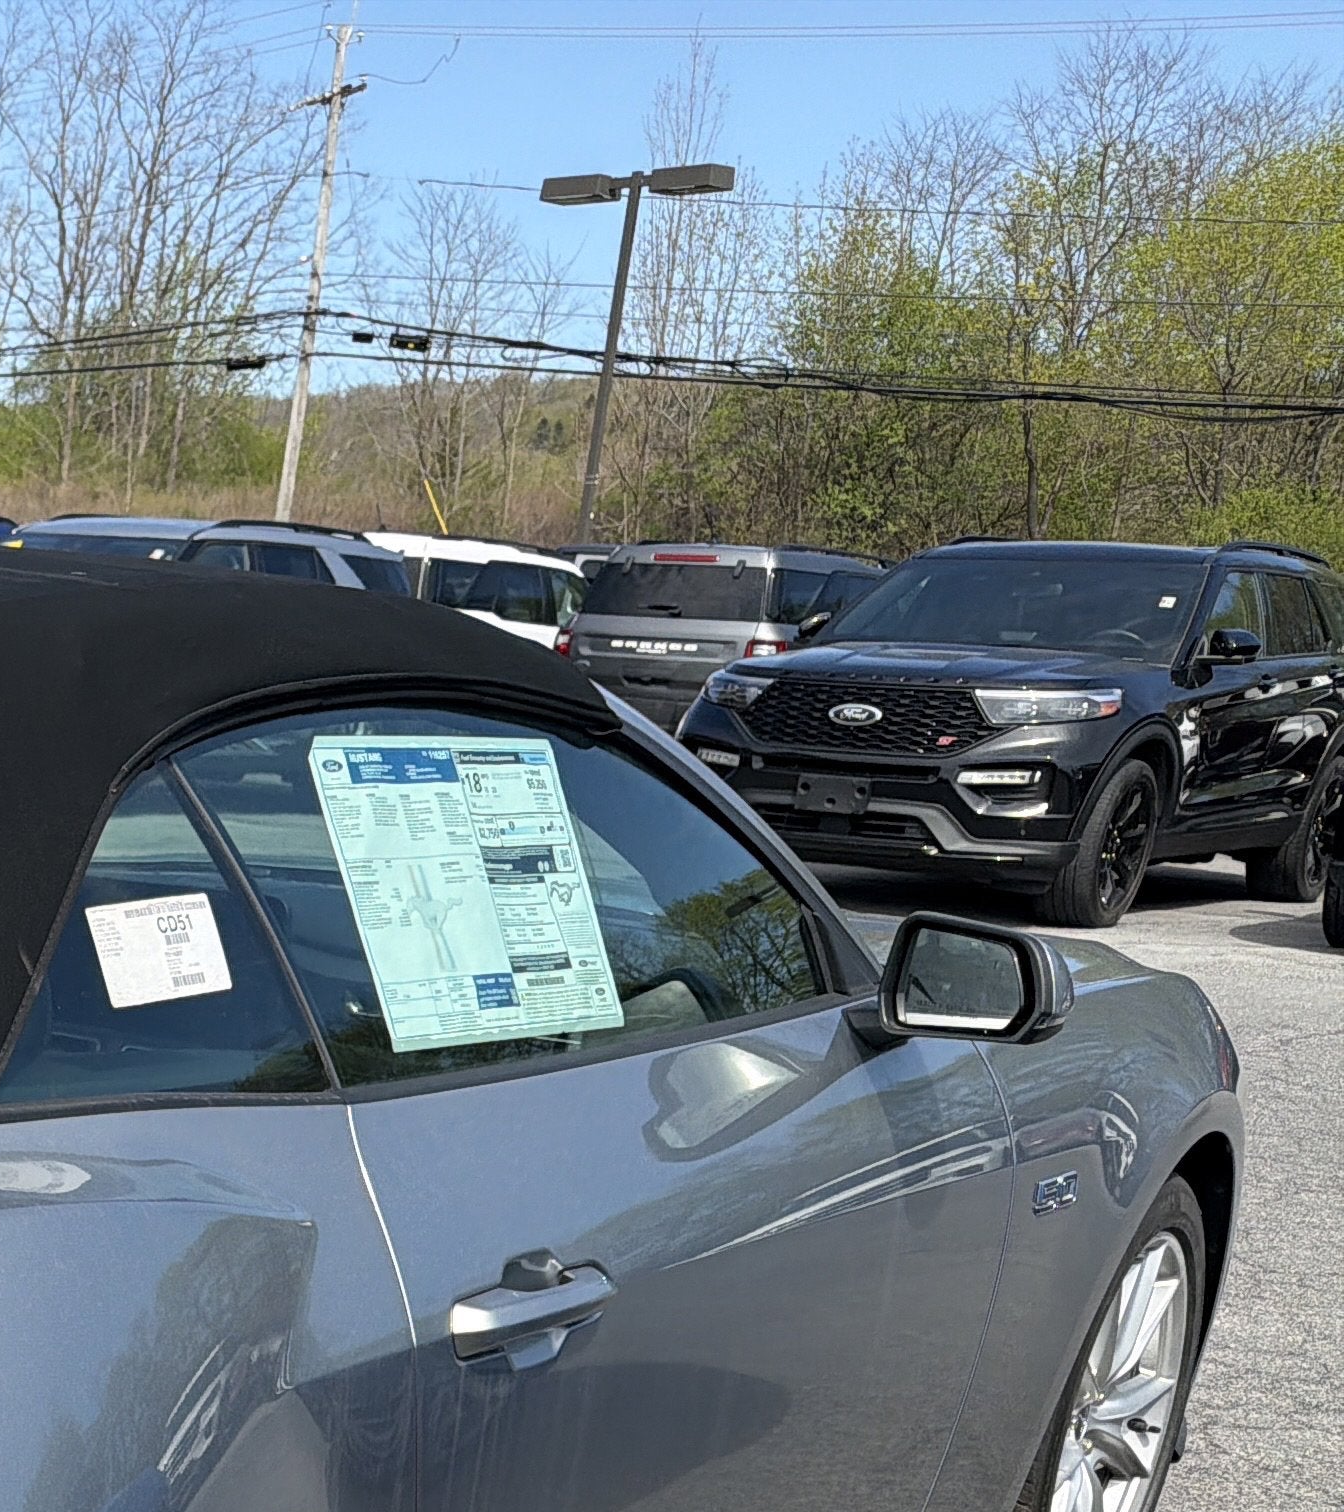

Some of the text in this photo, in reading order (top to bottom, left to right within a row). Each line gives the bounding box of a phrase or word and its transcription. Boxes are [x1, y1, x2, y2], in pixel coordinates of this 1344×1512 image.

[838, 708, 871, 721] Ford
[465, 772, 483, 793] 18
[156, 913, 194, 934] CD51
